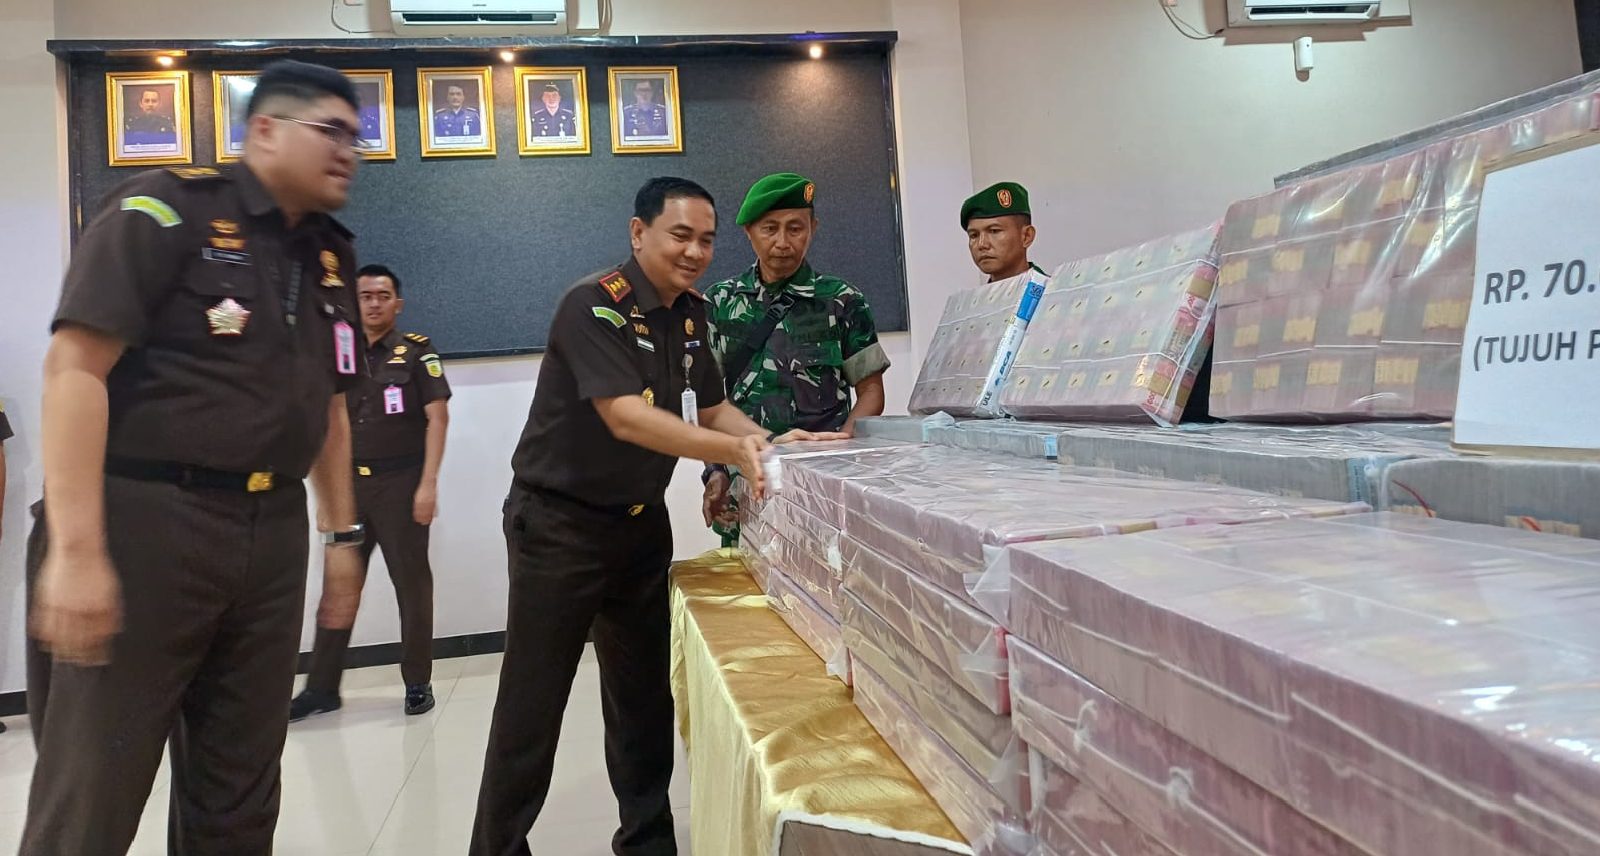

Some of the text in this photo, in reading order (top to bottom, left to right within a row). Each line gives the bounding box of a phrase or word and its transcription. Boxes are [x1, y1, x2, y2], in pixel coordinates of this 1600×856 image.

[1483, 259, 1595, 305] RP. 70.
[1473, 330, 1577, 372] (TUJUH
